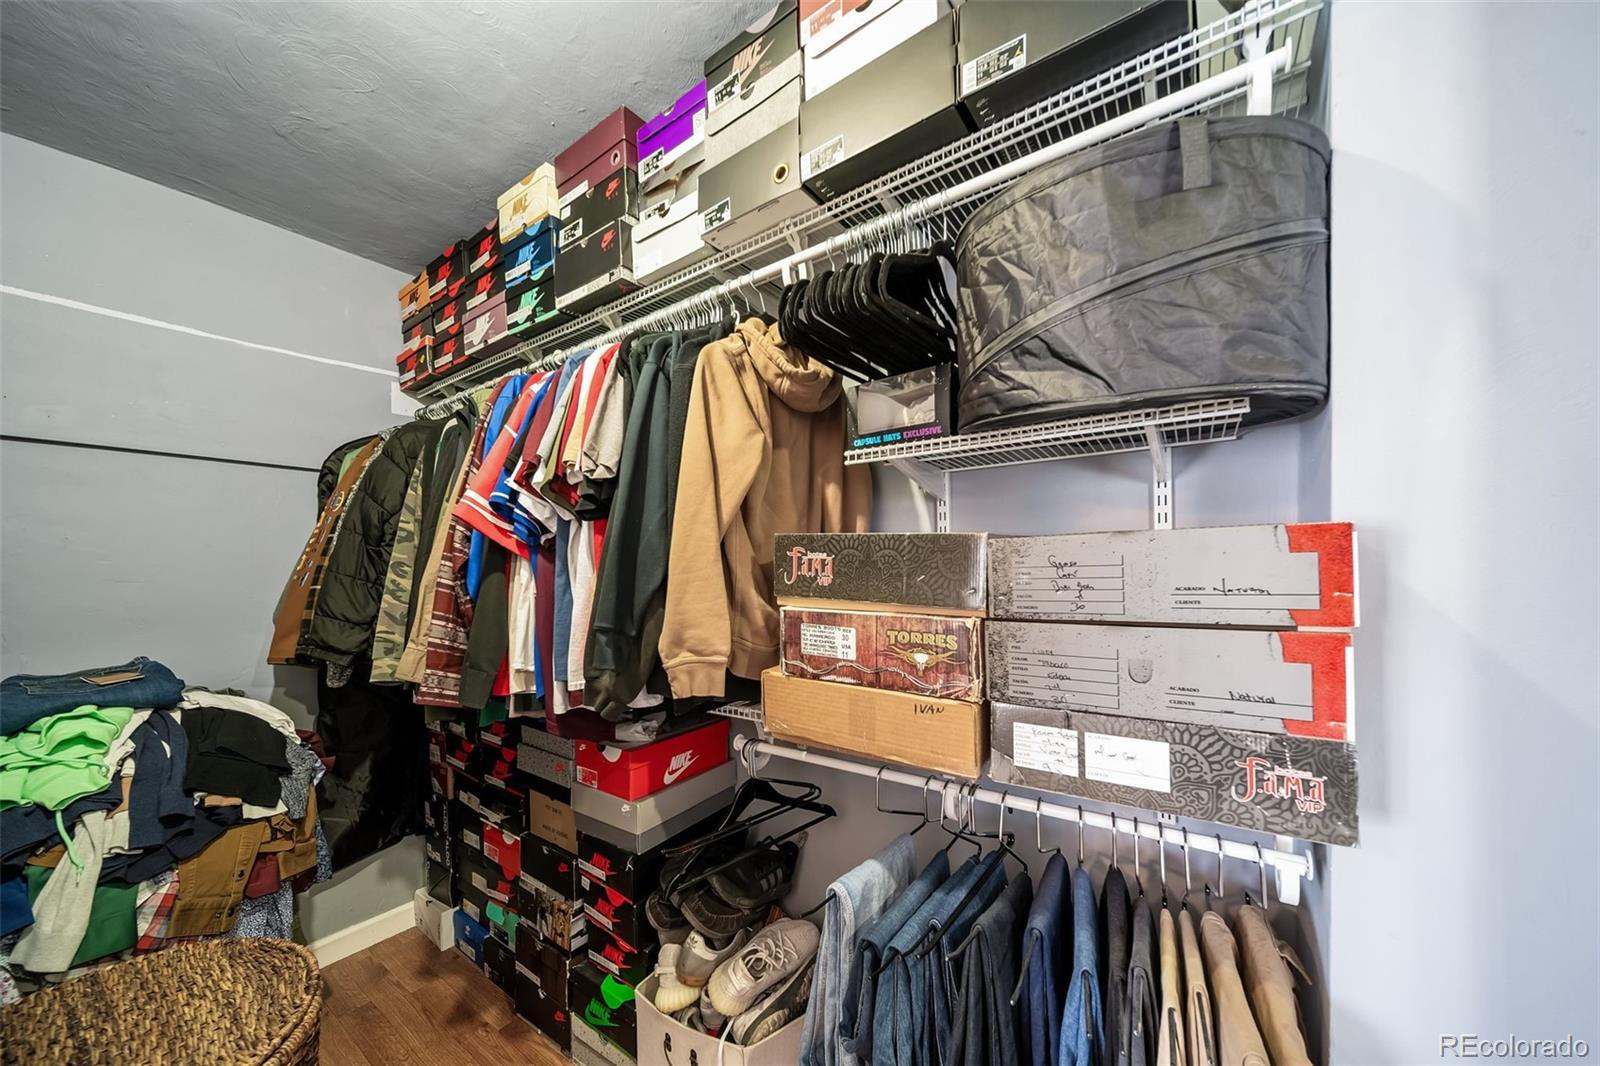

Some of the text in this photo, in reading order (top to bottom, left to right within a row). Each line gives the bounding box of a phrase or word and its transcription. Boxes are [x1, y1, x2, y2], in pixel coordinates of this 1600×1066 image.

[853, 425, 943, 447] CAPSULE HATS EXCLUSIVE
[887, 630, 958, 651] TORRES
[913, 704, 945, 715] IVAN
[669, 750, 693, 772] NIKE
[1295, 800, 1325, 814] VIP
